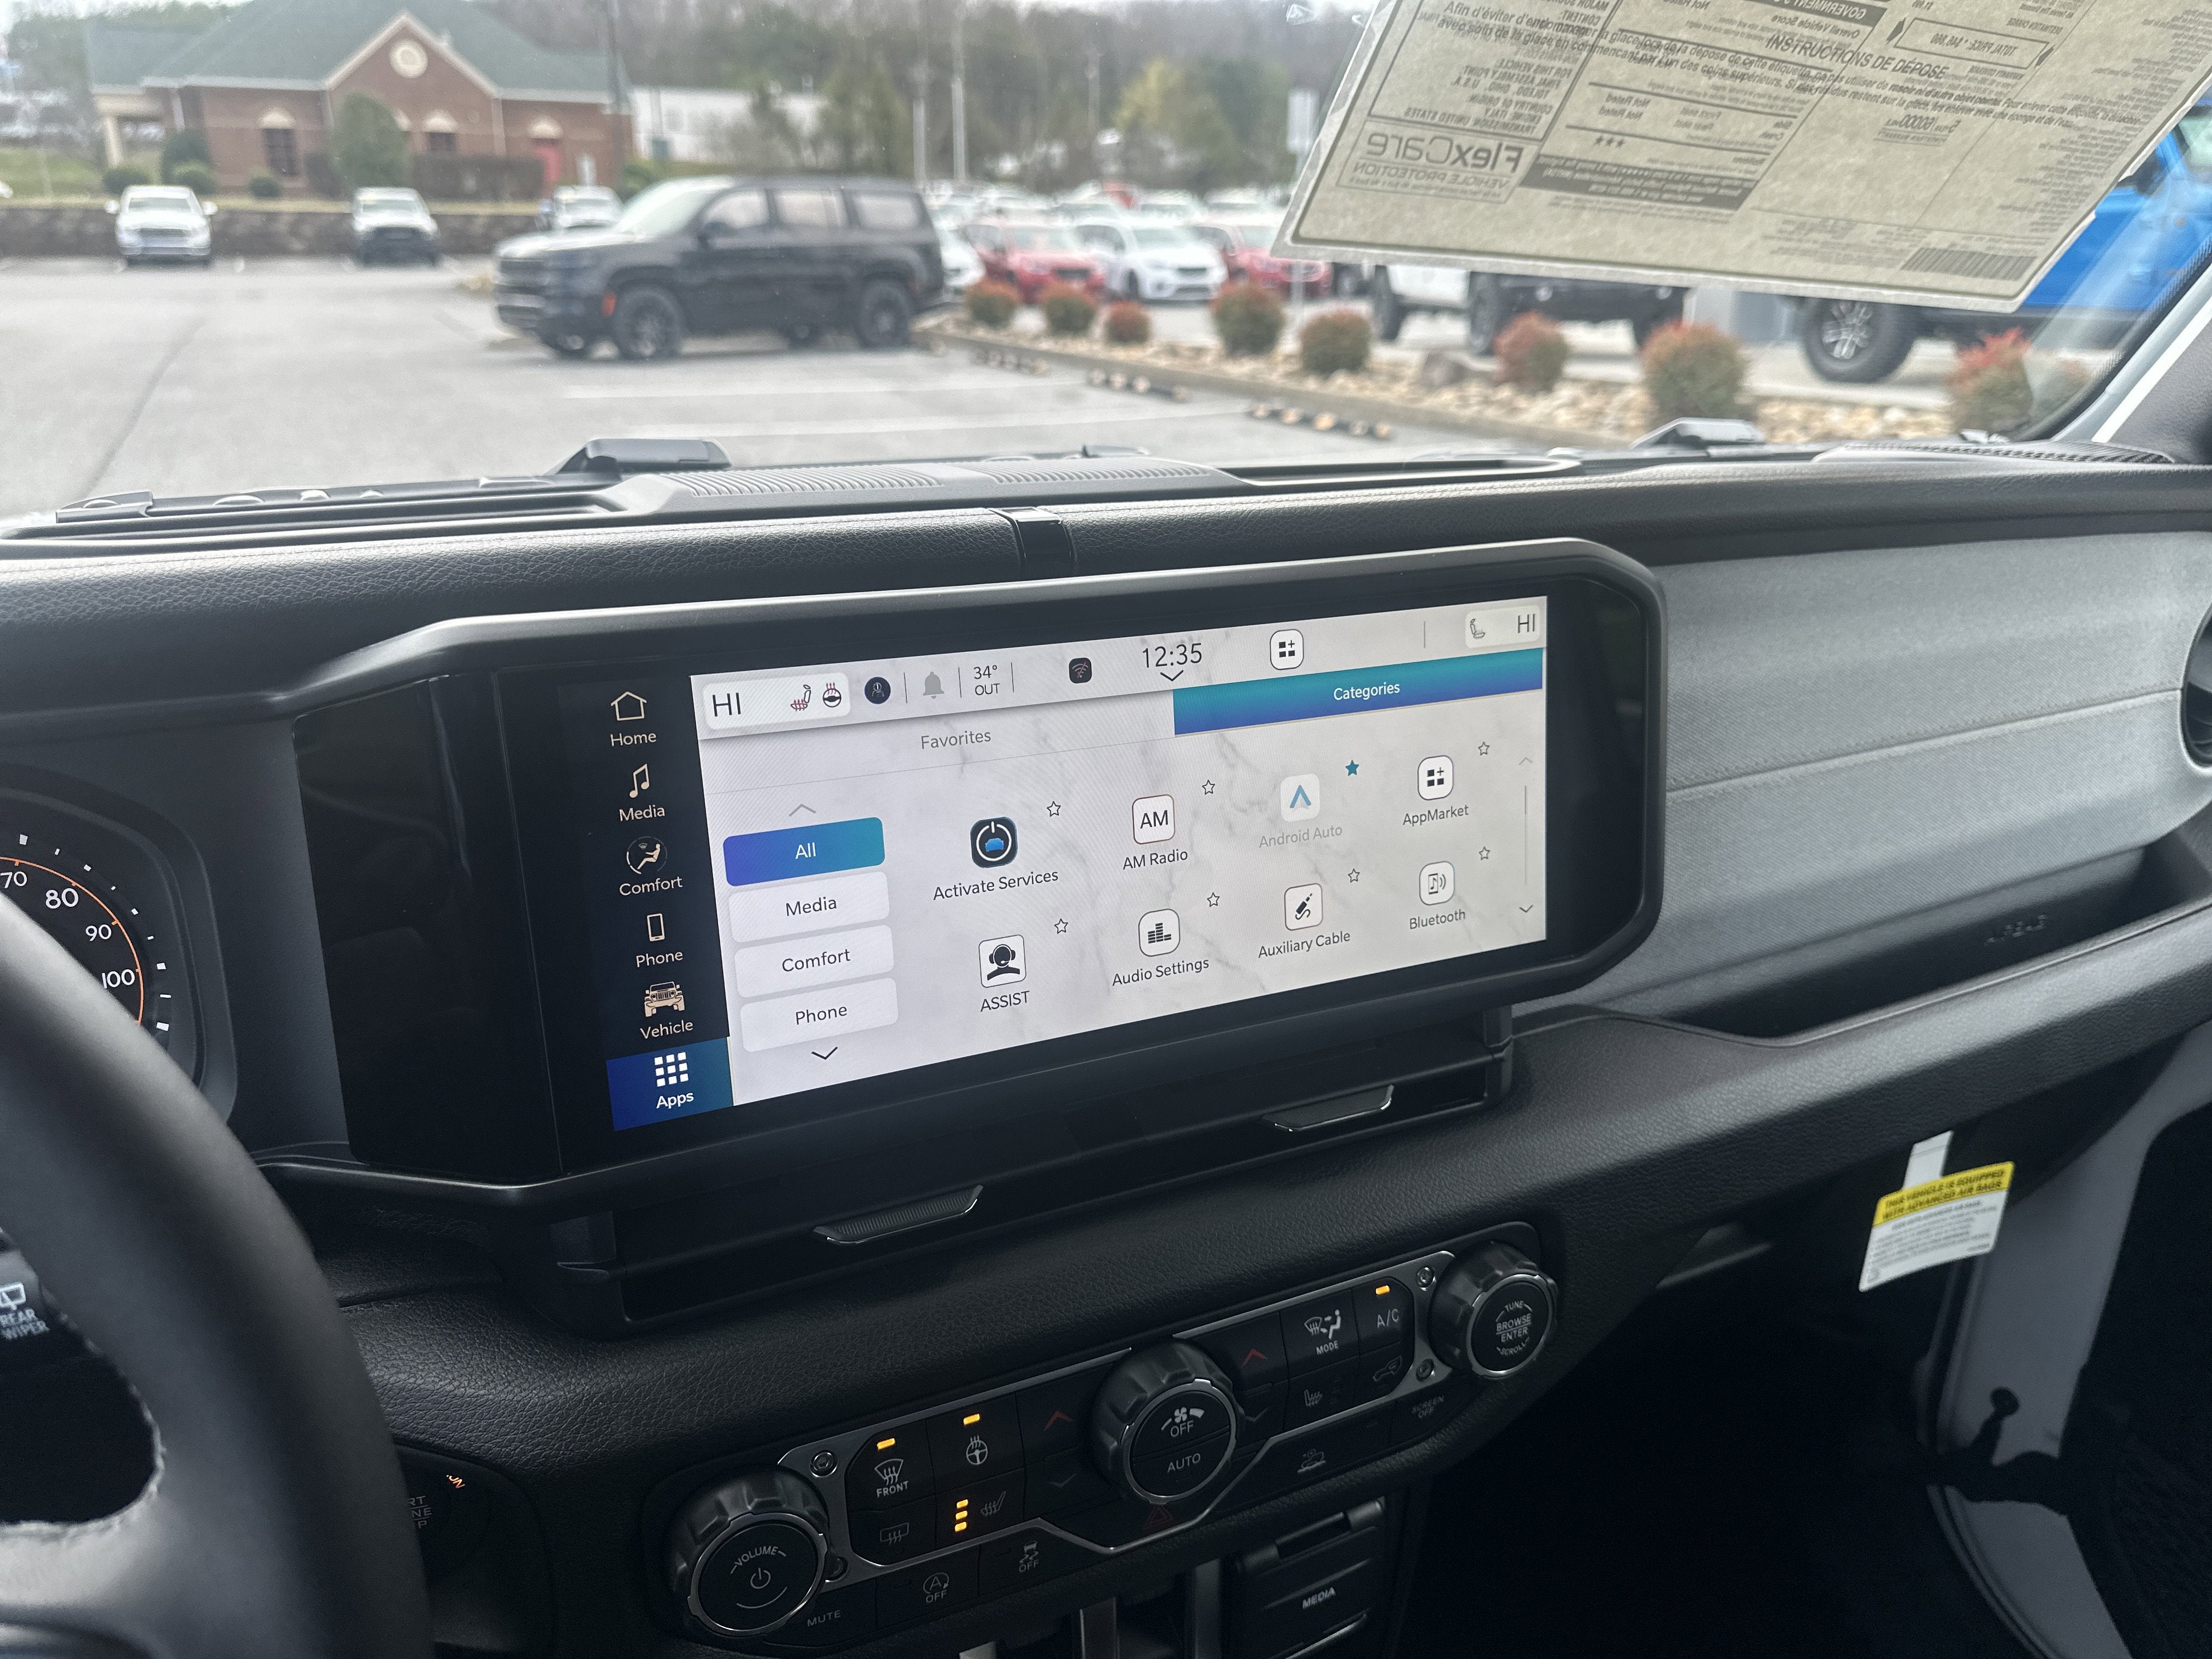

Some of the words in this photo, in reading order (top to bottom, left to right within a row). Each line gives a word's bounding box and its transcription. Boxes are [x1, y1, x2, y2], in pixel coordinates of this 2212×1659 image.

[1437, 19, 1466, 32] avec
[1444, 1, 1470, 17] Afin
[1471, 6, 1516, 24] d'éviter
[1609, 30, 1640, 46] glace
[1765, 33, 1873, 68] INSTRUCTIONS
[1871, 55, 1895, 70] DE
[1891, 57, 1950, 80] DÉPOSE
[1516, 613, 1537, 634] HI
[1142, 642, 1203, 669] 12:35
[973, 664, 998, 681] 34°
[974, 682, 1000, 697] OUT
[1333, 680, 1401, 702] Categories
[712, 692, 742, 718] HI
[610, 729, 657, 747] Home
[920, 728, 991, 750] Favorites
[618, 804, 665, 822] Media
[1139, 809, 1170, 830] AM
[1402, 804, 1469, 827] AppMarket
[1259, 829, 1308, 849] Android
[1310, 823, 1344, 841] Auto
[795, 842, 817, 859] All
[1122, 854, 1146, 871] AM
[1149, 849, 1189, 866] Radio
[1, 871, 27, 888] 70
[618, 876, 684, 898] Comfort
[933, 879, 995, 901] Activate
[998, 868, 1059, 890] Services
[46, 888, 79, 909] 80
[785, 895, 838, 917] Media
[1409, 908, 1466, 930] Bluetooth
[85, 924, 112, 941] 90
[1257, 938, 1313, 960] Auxiliary
[1315, 929, 1351, 948] Cable
[635, 949, 684, 969] Phone
[781, 948, 851, 973] Comfort
[101, 969, 136, 989] 100
[1111, 968, 1152, 987] Audio
[1154, 956, 1210, 982] Settings
[980, 990, 1030, 1012] ASSIST
[795, 1003, 848, 1026] Phone
[640, 1018, 694, 1040] Vehicle
[656, 1091, 695, 1109] Apps
[1504, 1300, 1524, 1312] TUNE
[1376, 1307, 1401, 1329] A/C
[1497, 1312, 1532, 1331] BROWSE
[1500, 1327, 1529, 1342] ENTER
[1315, 1339, 1339, 1356] MODE
[1170, 1420, 1194, 1438] OFF
[1166, 1452, 1202, 1474] AUTO
[445, 1474, 466, 1489] UN
[876, 1480, 910, 1497] FRONT
[734, 1545, 779, 1569] VOLUME
[1018, 1558, 1040, 1573] OFF
[925, 1588, 948, 1603] OFF
[1302, 1587, 1337, 1609] MEDIA
[806, 1610, 842, 1628] MUTE
